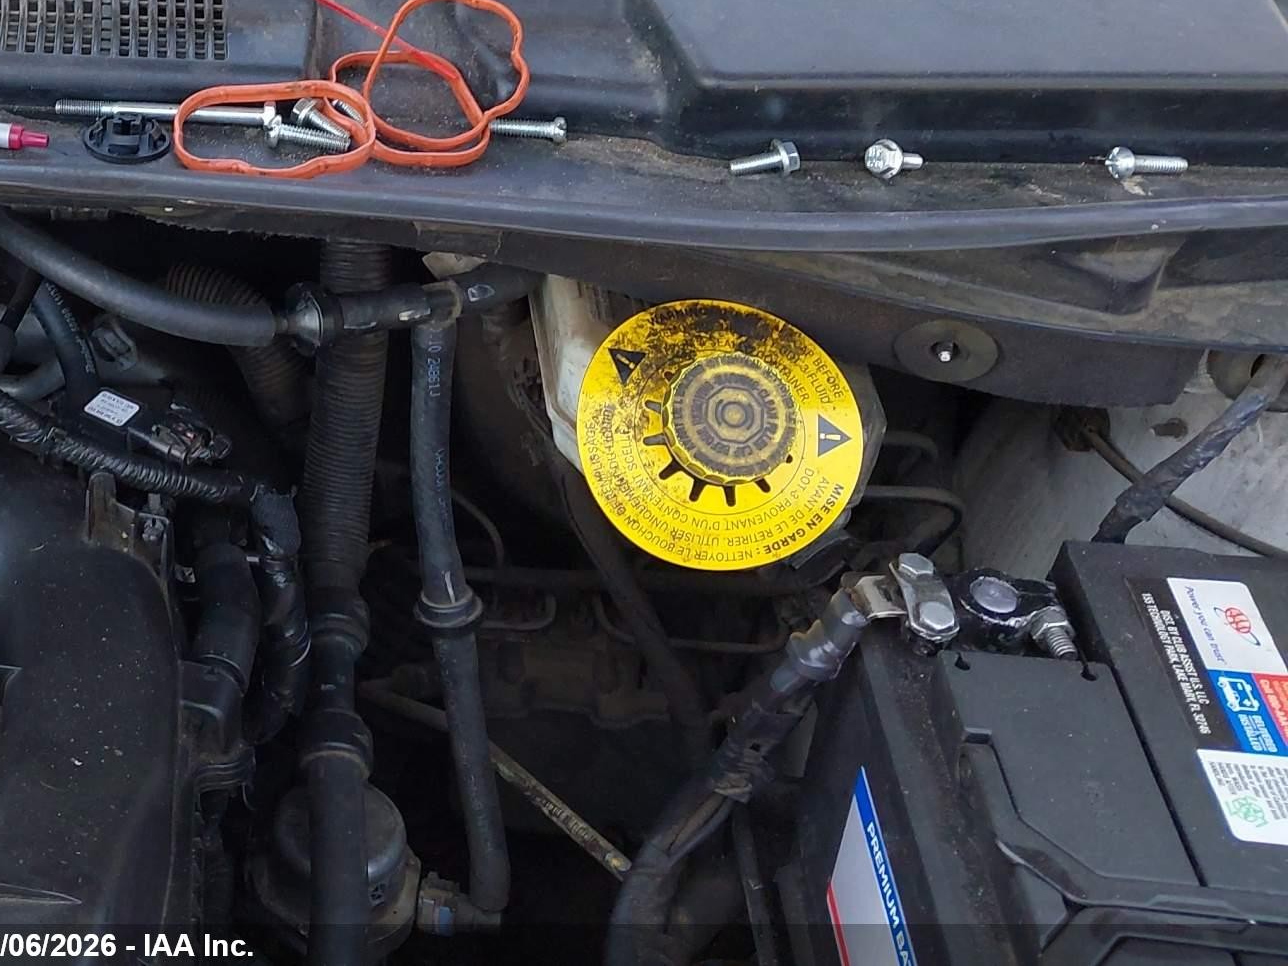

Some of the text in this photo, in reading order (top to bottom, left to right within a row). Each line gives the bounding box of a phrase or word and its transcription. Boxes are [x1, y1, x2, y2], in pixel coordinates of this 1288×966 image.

[630, 472, 689, 524] CONTENANT
[801, 475, 831, 512] AVANT
[819, 483, 845, 515] MISE
[689, 516, 720, 530] D'UN
[725, 496, 792, 531] PROVENANT
[787, 508, 805, 524] DE
[805, 512, 823, 530] EN
[622, 514, 675, 552] BOUCHON
[667, 525, 719, 546] UTILISER
[773, 519, 789, 533] LE
[674, 545, 691, 557] LE
[693, 549, 753, 561] NETTOYER
[1148, 604, 1171, 644] TECHNOLOGY
[1185, 586, 1201, 611] Power
[1194, 610, 1208, 628] you
[1204, 627, 1214, 642] can
[1168, 624, 1180, 636] BY
[1172, 636, 1187, 653] CLUB
[1172, 664, 1187, 681] LAKE
[1180, 654, 1197, 676] ASSIST
[1189, 701, 1200, 712] FL
[1195, 689, 1210, 705] LLC
[1192, 712, 1211, 734] 32746
[1238, 714, 1263, 752] INSTALLED
[1252, 715, 1278, 753] DELIVERED
[867, 822, 900, 929] PREMIUM
